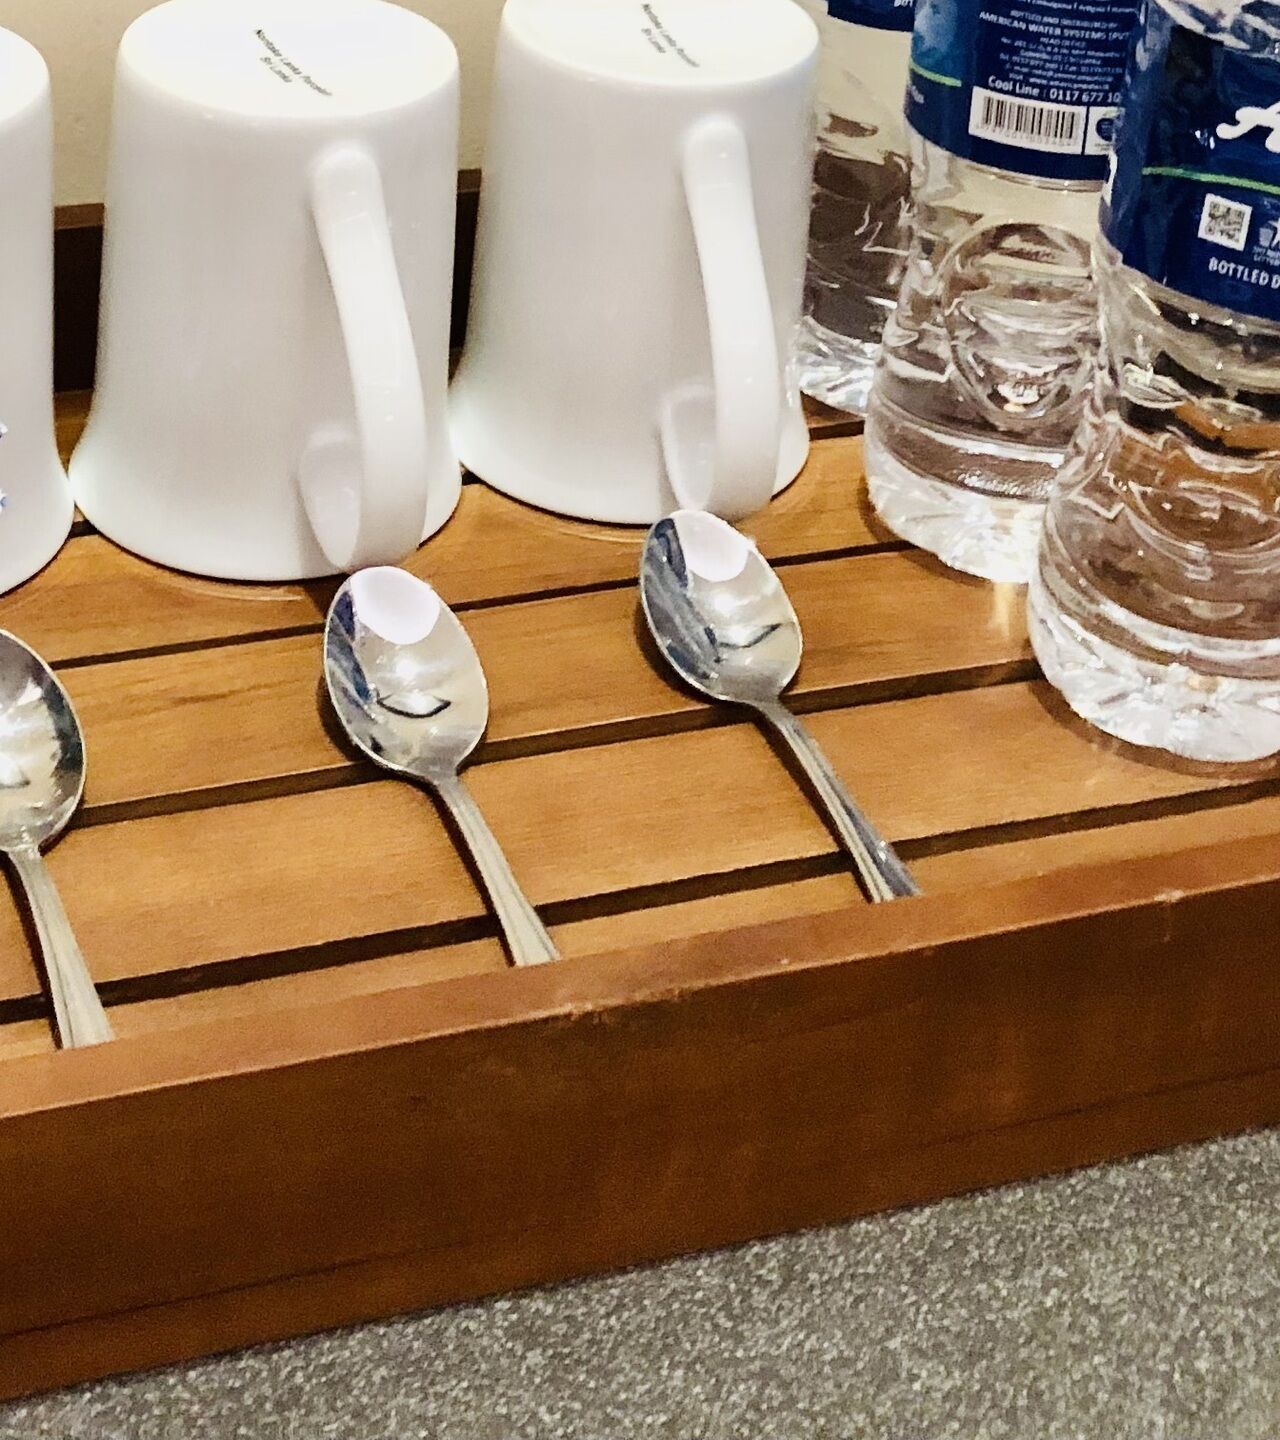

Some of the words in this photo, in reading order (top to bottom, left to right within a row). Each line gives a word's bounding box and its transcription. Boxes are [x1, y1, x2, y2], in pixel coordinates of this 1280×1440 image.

[1028, 22, 1062, 36] WATER
[988, 75, 1013, 92] Cool
[1015, 82, 1040, 97] Line
[1049, 88, 1078, 101] 0117
[1081, 91, 1104, 102] 677
[1107, 92, 1121, 103] 10
[1208, 257, 1269, 286] BOTTLED
